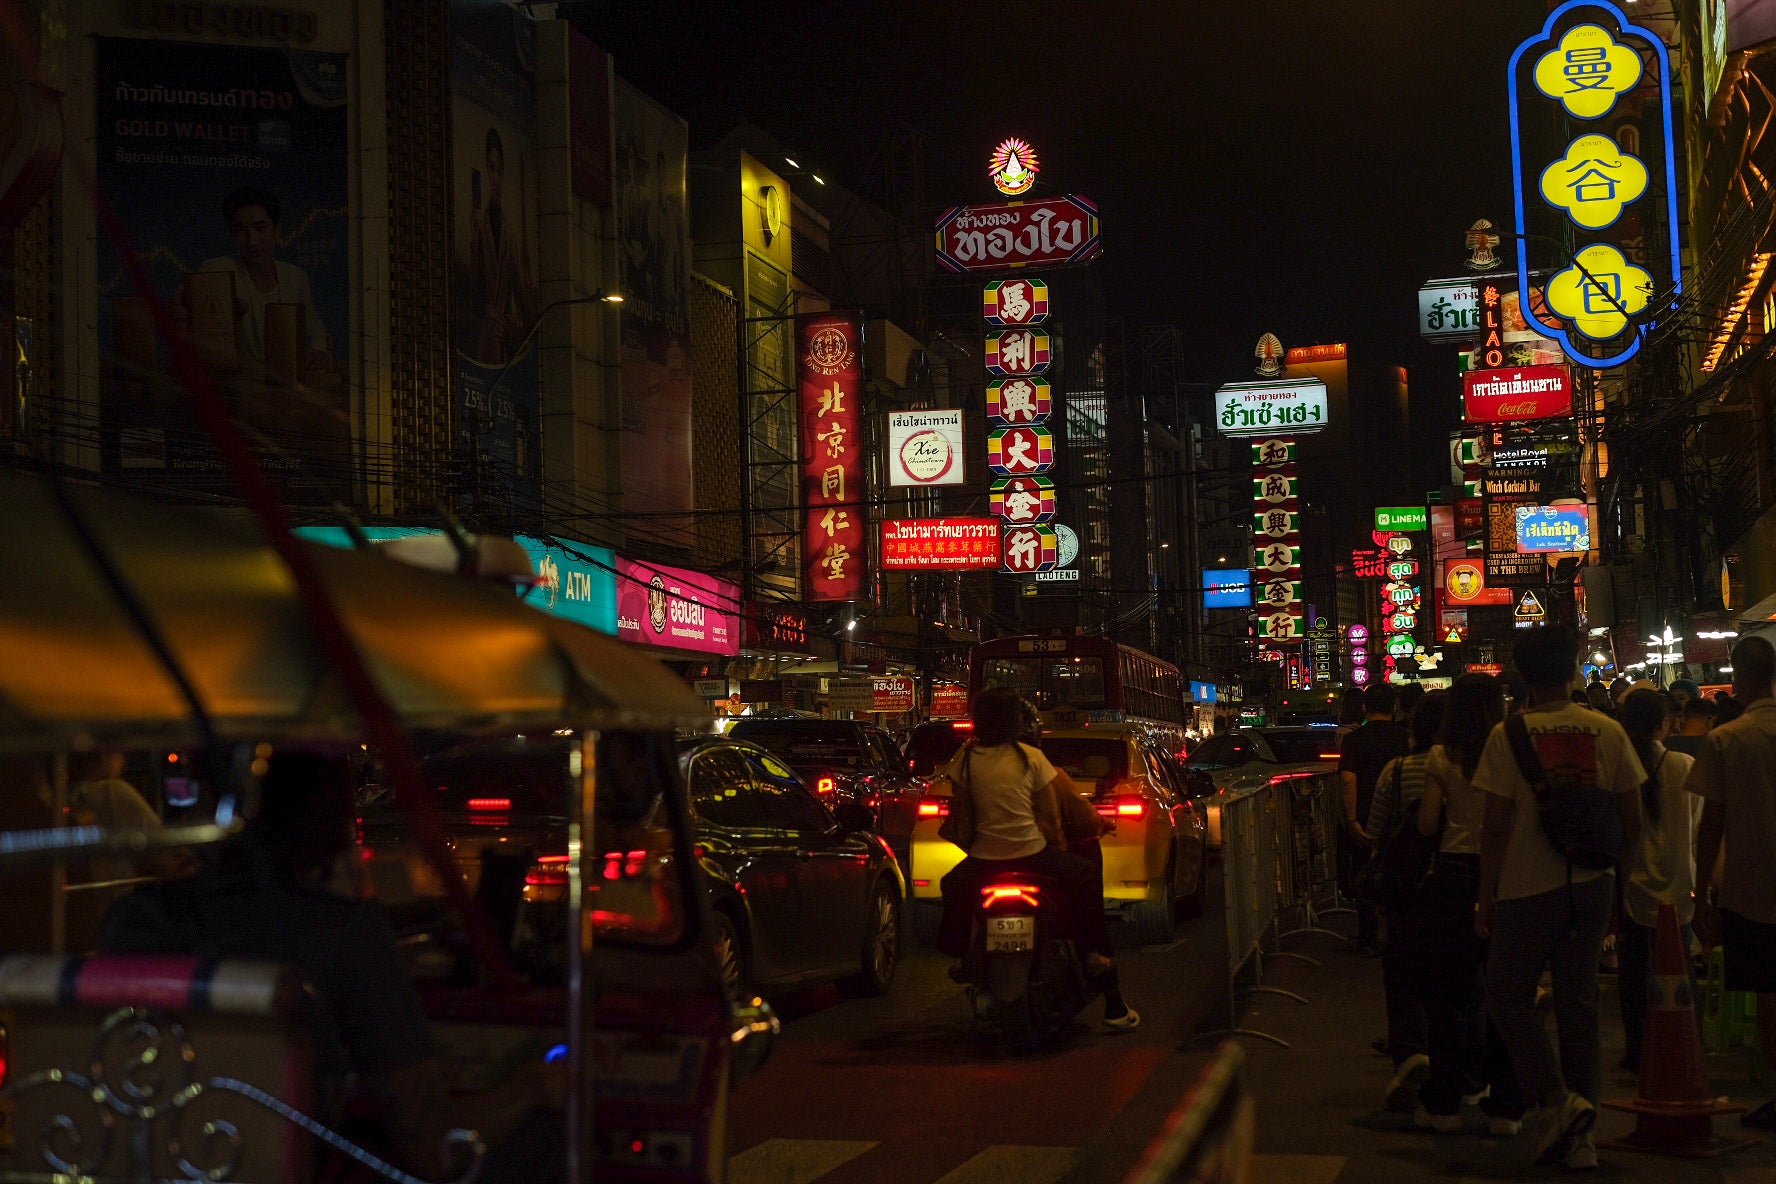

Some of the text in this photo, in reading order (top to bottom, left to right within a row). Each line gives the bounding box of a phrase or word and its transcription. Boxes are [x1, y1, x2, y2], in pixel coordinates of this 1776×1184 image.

[115, 117, 252, 142] GOLD WALLET
[1563, 46, 1628, 314] 曼谷包
[955, 210, 1020, 229] ห้างทอง
[953, 208, 1092, 262] ทองใบ
[822, 367, 839, 375] REN
[1001, 282, 1041, 568] 馬利興大金行
[913, 441, 940, 456] Xie
[817, 381, 850, 580] 北京同仁堂
[1488, 469, 1530, 477] WARNING
[1263, 442, 1292, 638] 和成興大金行
[1489, 565, 1541, 574] IN THE BREW
[565, 571, 592, 602] ATM
[1220, 583, 1246, 593] UOB
[1241, 716, 1264, 725] TAXI
